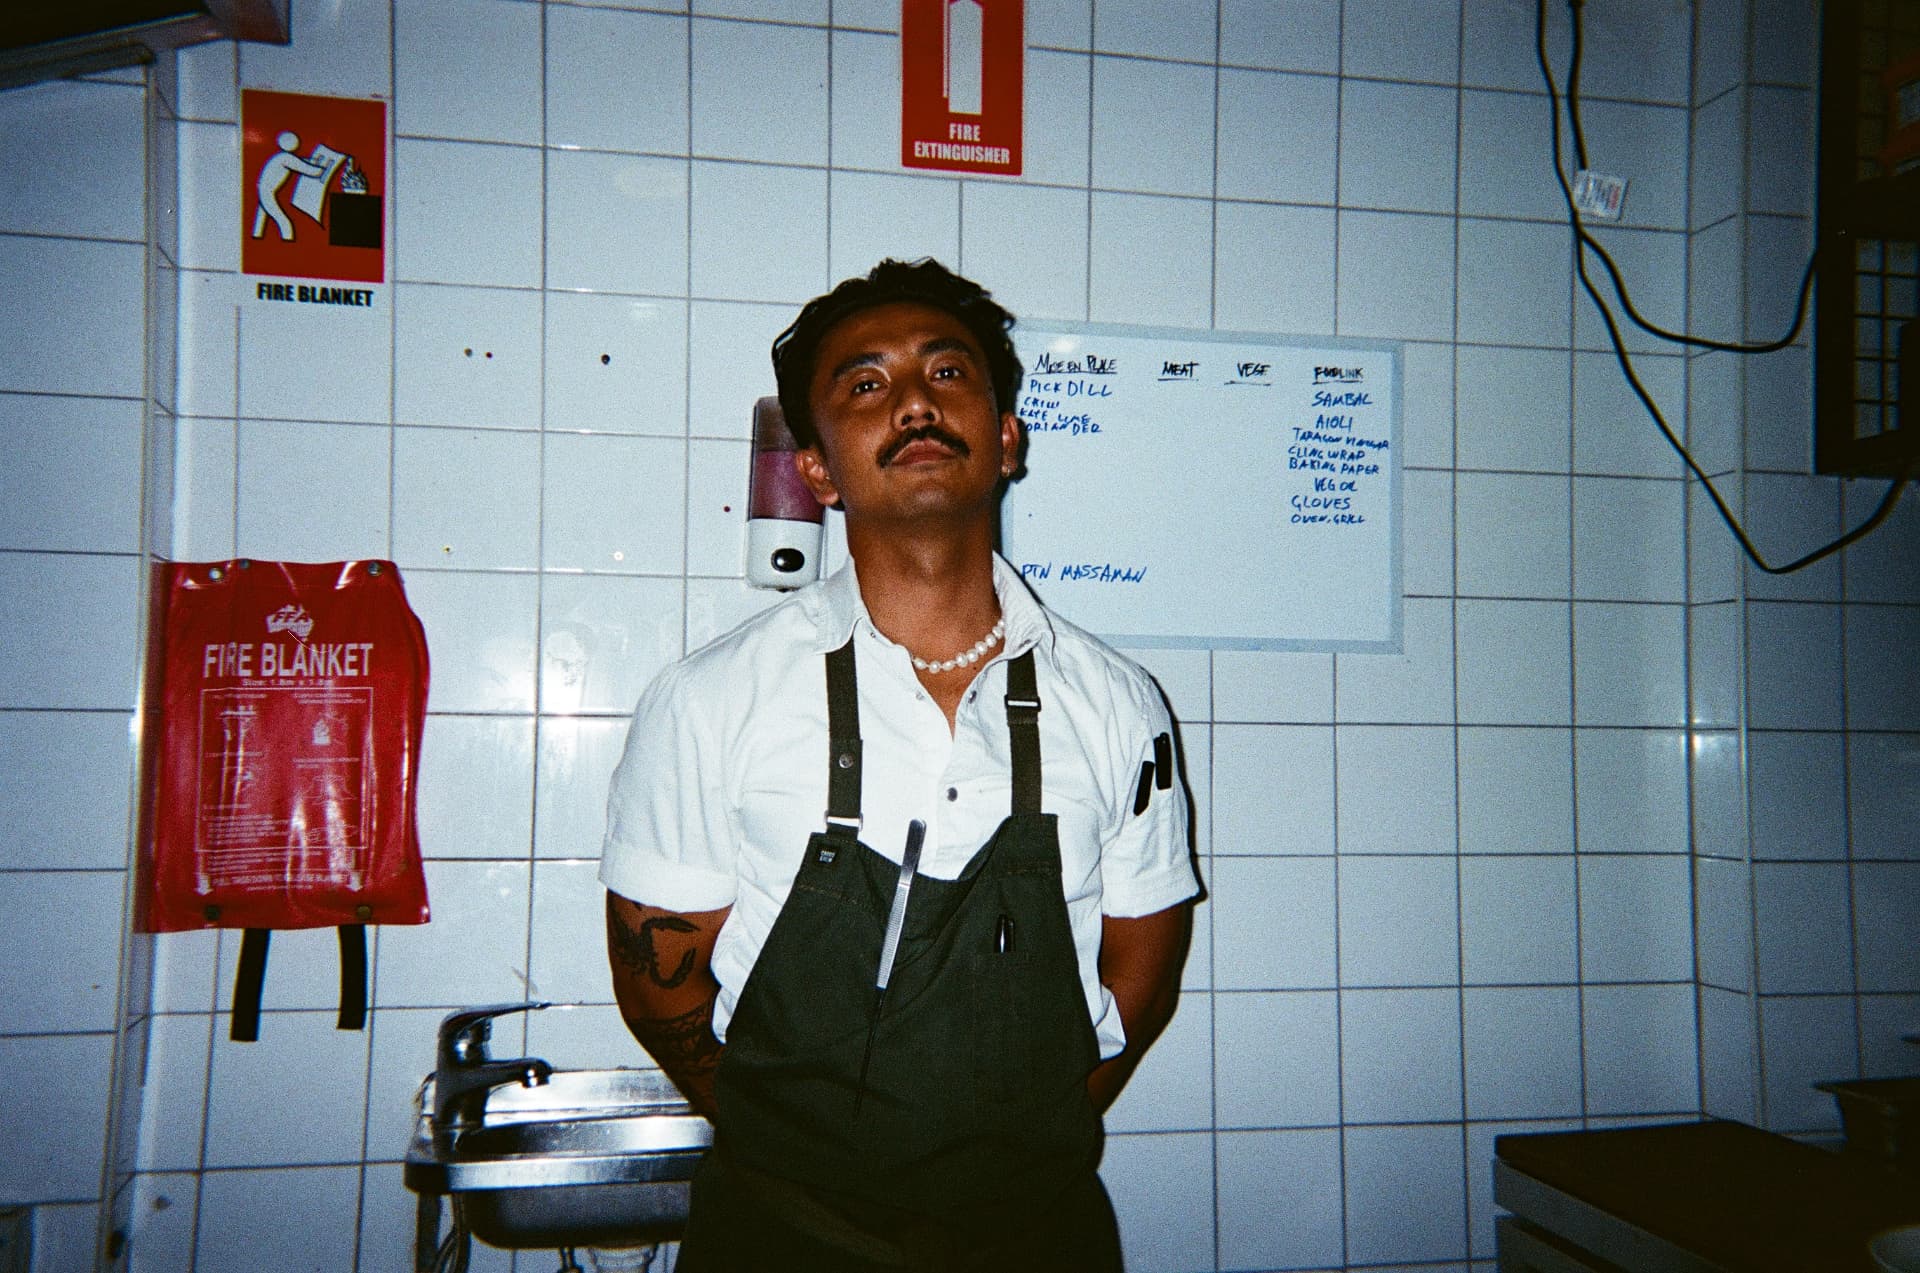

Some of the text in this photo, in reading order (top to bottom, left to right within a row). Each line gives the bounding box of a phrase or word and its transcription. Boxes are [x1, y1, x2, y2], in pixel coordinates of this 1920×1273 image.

[949, 123, 981, 142] FIRE
[914, 141, 1011, 165] EXTINGUISHER
[257, 282, 374, 307] FIRE BLANKET
[1162, 361, 1200, 377] MEAT
[1030, 379, 1113, 397] PICK DILL
[1311, 391, 1374, 407] SAMBAL
[1315, 414, 1354, 433] AIOLI
[1327, 449, 1366, 461] WRAP
[1288, 457, 1380, 476] BAKING PAPER
[1314, 477, 1336, 493] VEG
[1291, 495, 1352, 512] GLOVES
[1060, 563, 1147, 583] MASSAMAN
[203, 642, 375, 678] FIRE BLANKET
